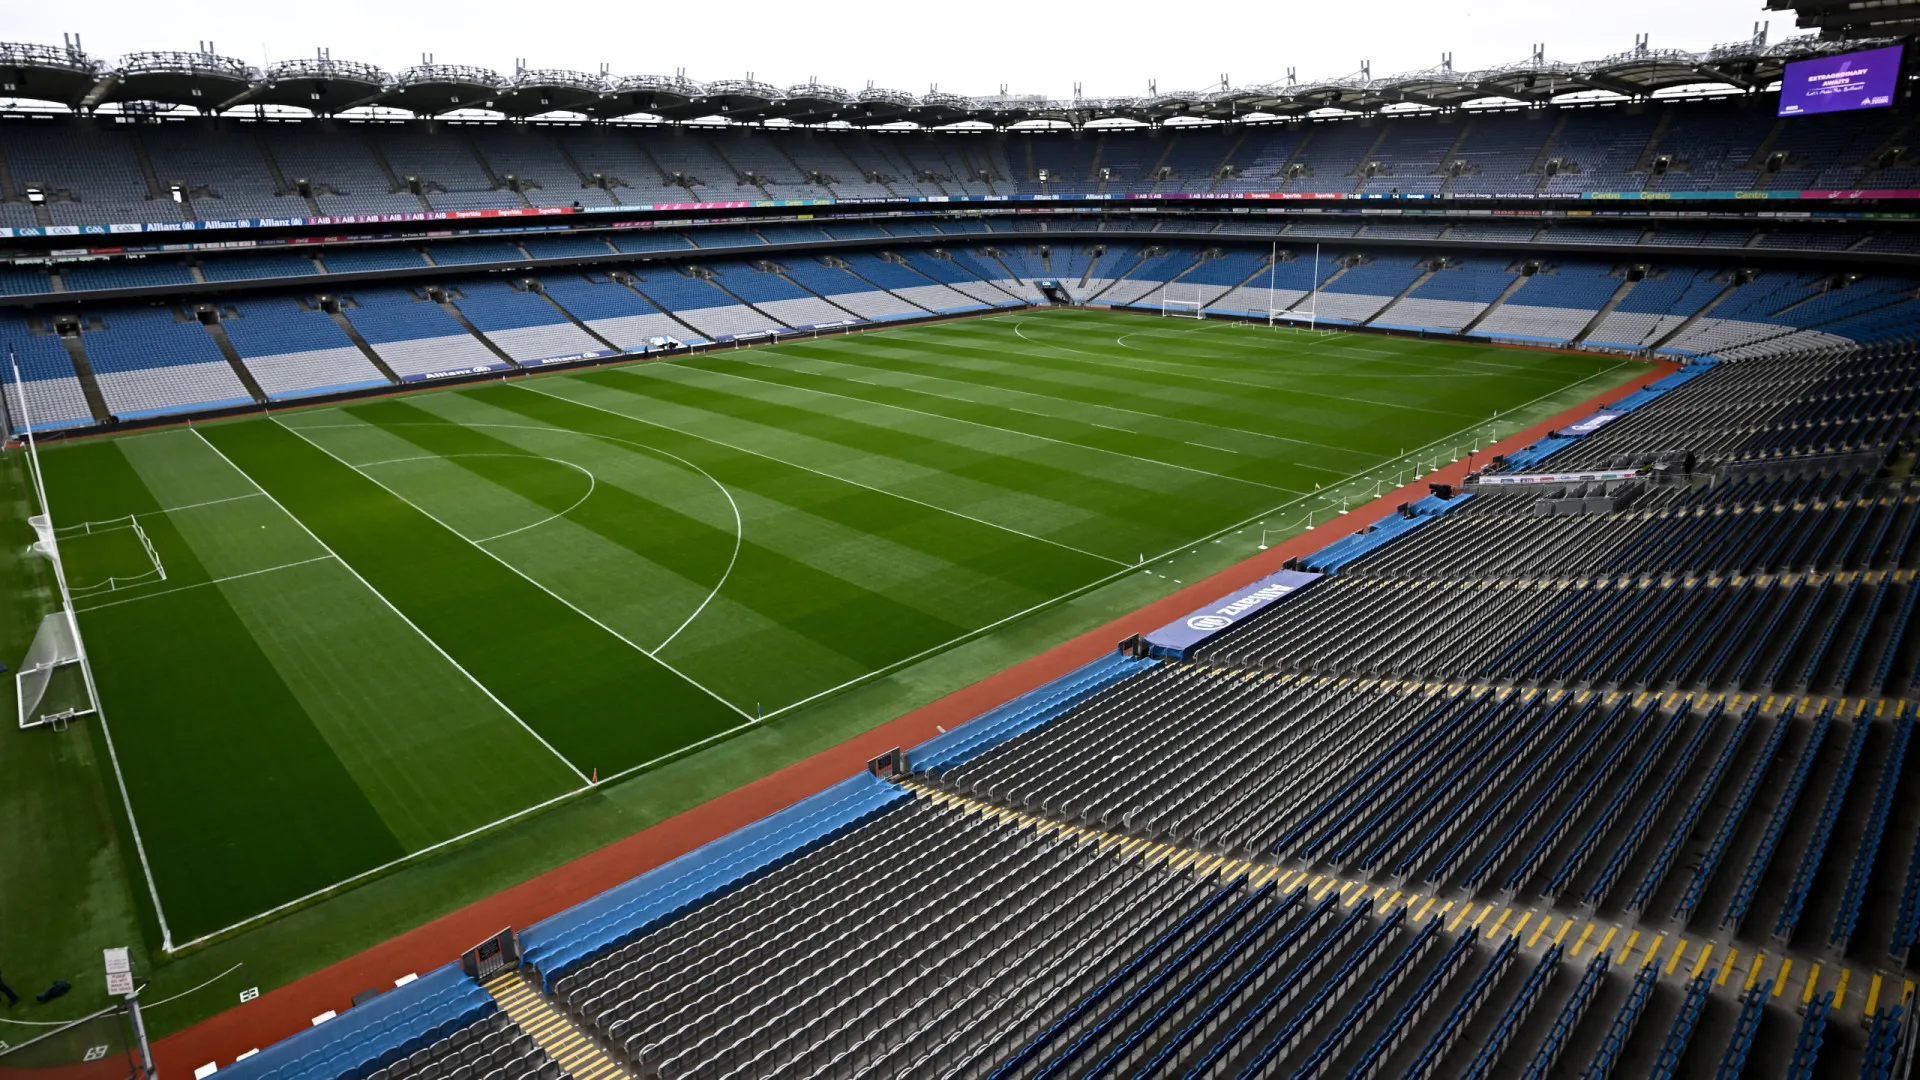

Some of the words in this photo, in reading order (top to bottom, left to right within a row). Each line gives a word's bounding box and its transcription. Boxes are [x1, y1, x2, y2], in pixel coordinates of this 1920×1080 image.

[1808, 69, 1868, 82] EXTRAORDINARY
[1822, 78, 1850, 86] AWAITS
[1640, 191, 1671, 199] Centra
[1734, 191, 1768, 199] Centra
[1828, 191, 1841, 199] eir
[1850, 190, 1863, 199] eir
[412, 213, 425, 221] AIB
[147, 223, 181, 231] Allianz
[205, 220, 237, 229] Allianz
[259, 219, 290, 228] Allianz
[541, 354, 583, 364] Allianz
[425, 369, 473, 379] Allianz
[1216, 583, 1294, 617] Allianz
